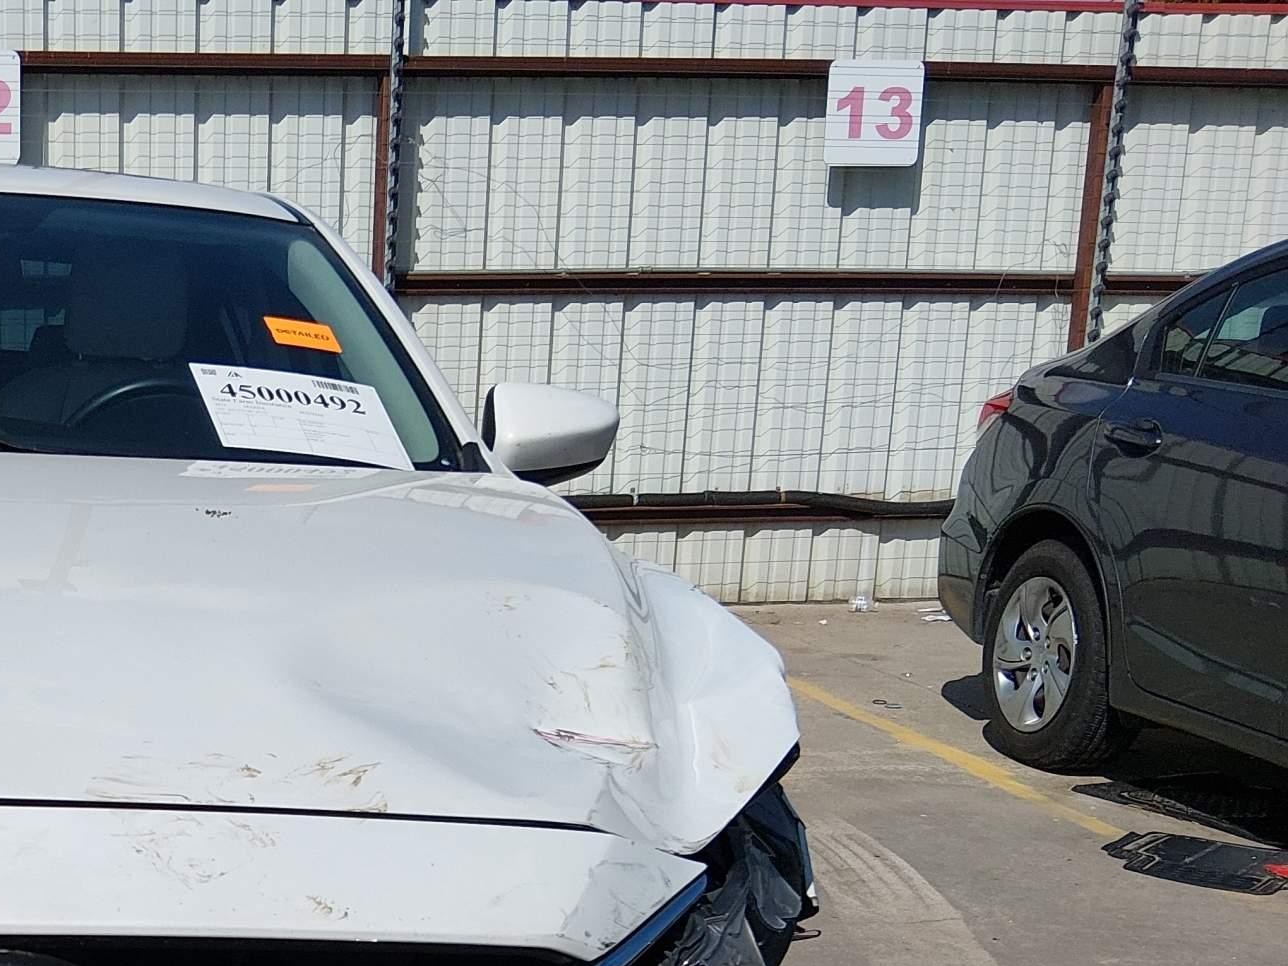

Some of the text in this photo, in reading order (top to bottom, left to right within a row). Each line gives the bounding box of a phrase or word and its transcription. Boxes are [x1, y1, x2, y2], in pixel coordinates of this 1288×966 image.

[837, 86, 913, 140] 13
[275, 327, 331, 342] DETAILED
[220, 383, 366, 415] 45000492
